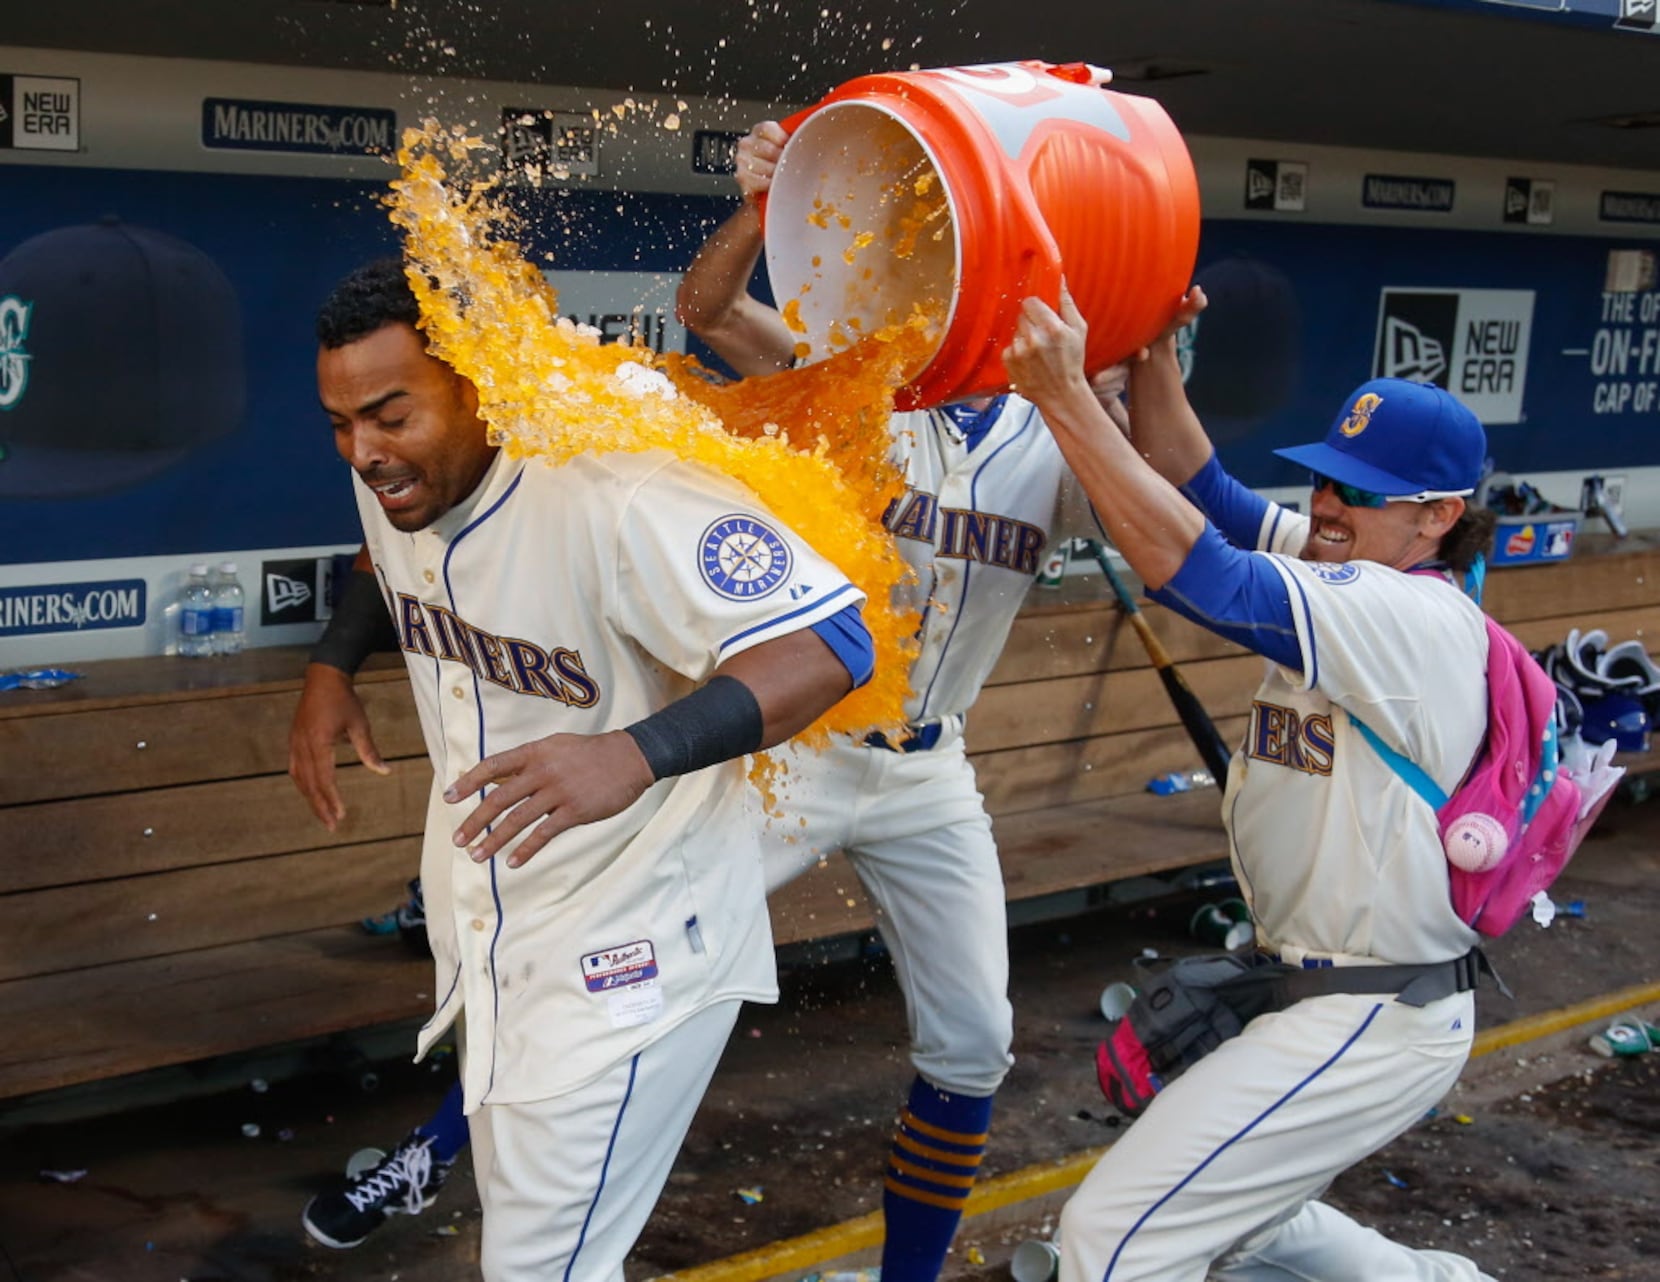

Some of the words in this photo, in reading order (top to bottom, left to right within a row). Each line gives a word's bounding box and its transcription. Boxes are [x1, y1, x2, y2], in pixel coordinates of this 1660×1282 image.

[23, 91, 70, 113] NEW
[23, 113, 70, 135] ERA
[1602, 292, 1635, 323] THE
[1465, 320, 1520, 355] NEW
[1462, 358, 1516, 393] ERA
[1593, 383, 1631, 414] CAP
[1633, 383, 1659, 413] OF
[705, 520, 755, 577] SEATTLE
[733, 540, 786, 595] MARINERS
